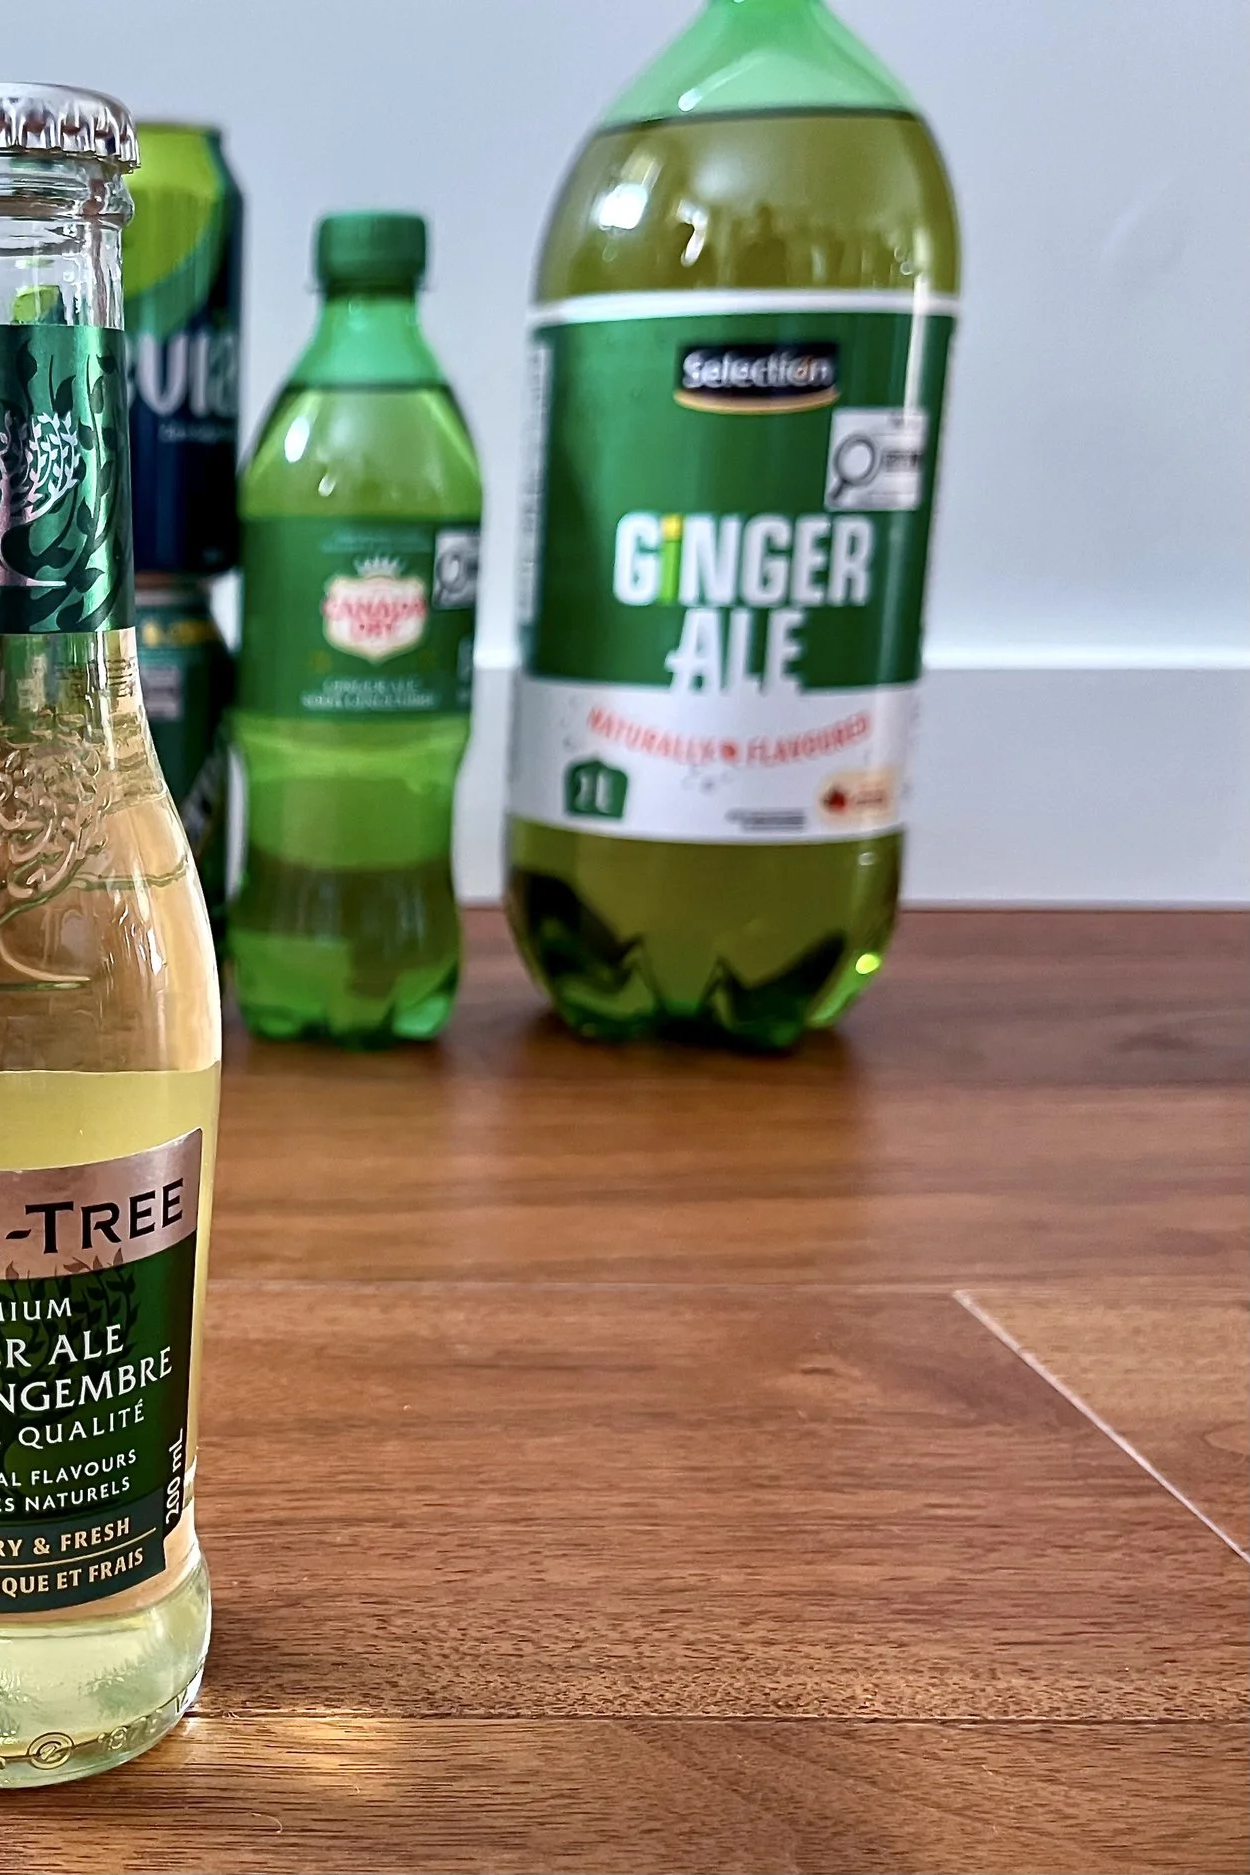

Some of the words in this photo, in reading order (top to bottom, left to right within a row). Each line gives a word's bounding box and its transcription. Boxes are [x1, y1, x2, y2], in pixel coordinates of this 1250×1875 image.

[681, 351, 834, 389] Selection
[664, 608, 808, 697] ALE
[587, 706, 717, 767] NATURALLY
[48, 1323, 125, 1367] ALE
[17, 1398, 145, 1450] QUALITÉ
[30, 1448, 138, 1486] FLAVOURS
[24, 1475, 131, 1512] NATURELS
[165, 1476, 181, 1524] 200
[32, 1537, 51, 1555] &
[60, 1516, 131, 1552] FRESH
[56, 1567, 83, 1590] ET
[88, 1547, 145, 1584] FRAIS
